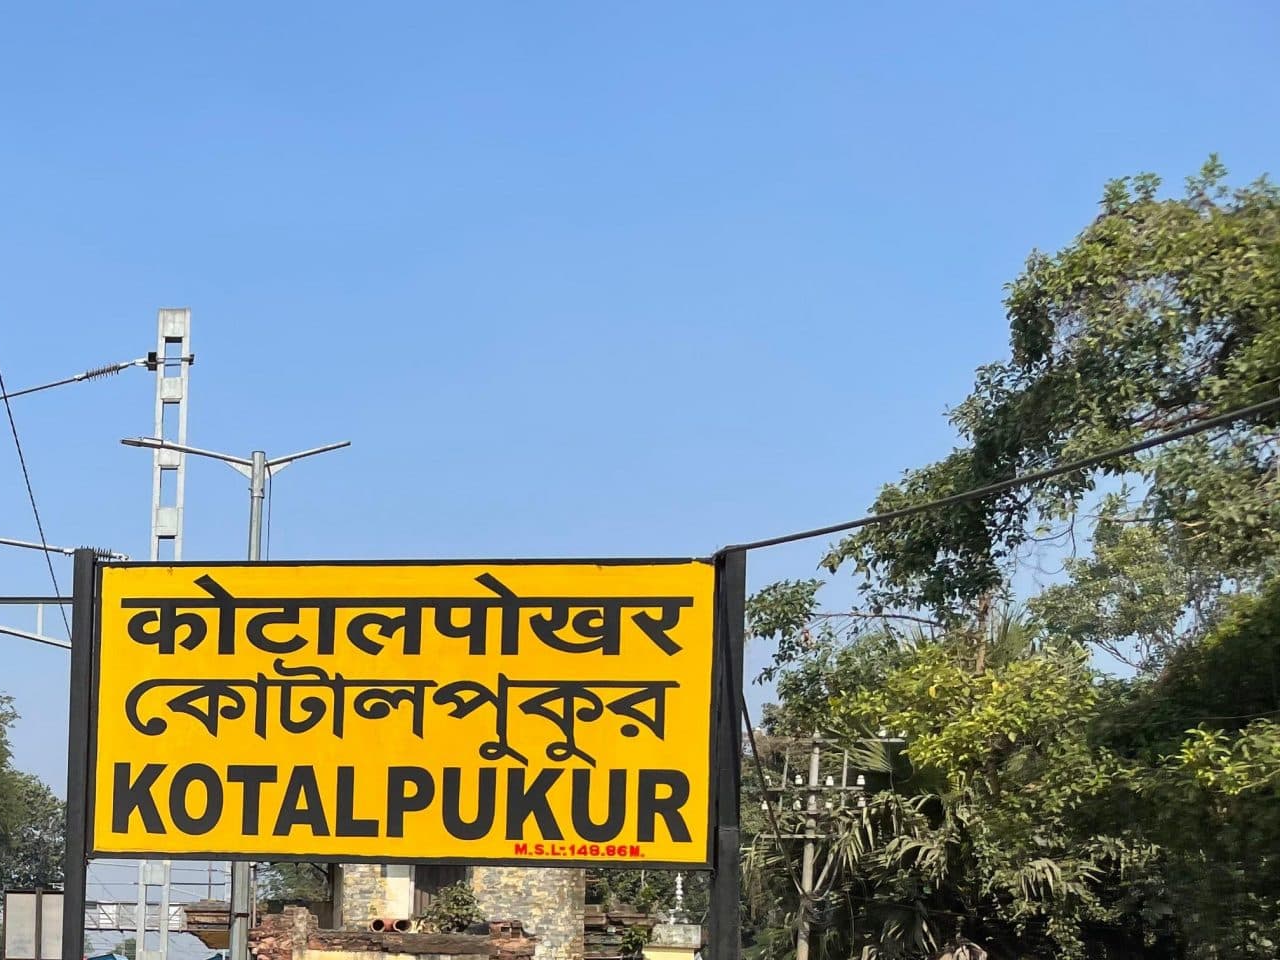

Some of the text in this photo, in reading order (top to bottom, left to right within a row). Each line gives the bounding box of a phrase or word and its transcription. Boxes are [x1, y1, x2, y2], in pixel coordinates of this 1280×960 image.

[121, 573, 693, 656] कोटालपोखर
[125, 658, 680, 767] কোটালপুকুর
[112, 762, 692, 843] KOTALPUKUR
